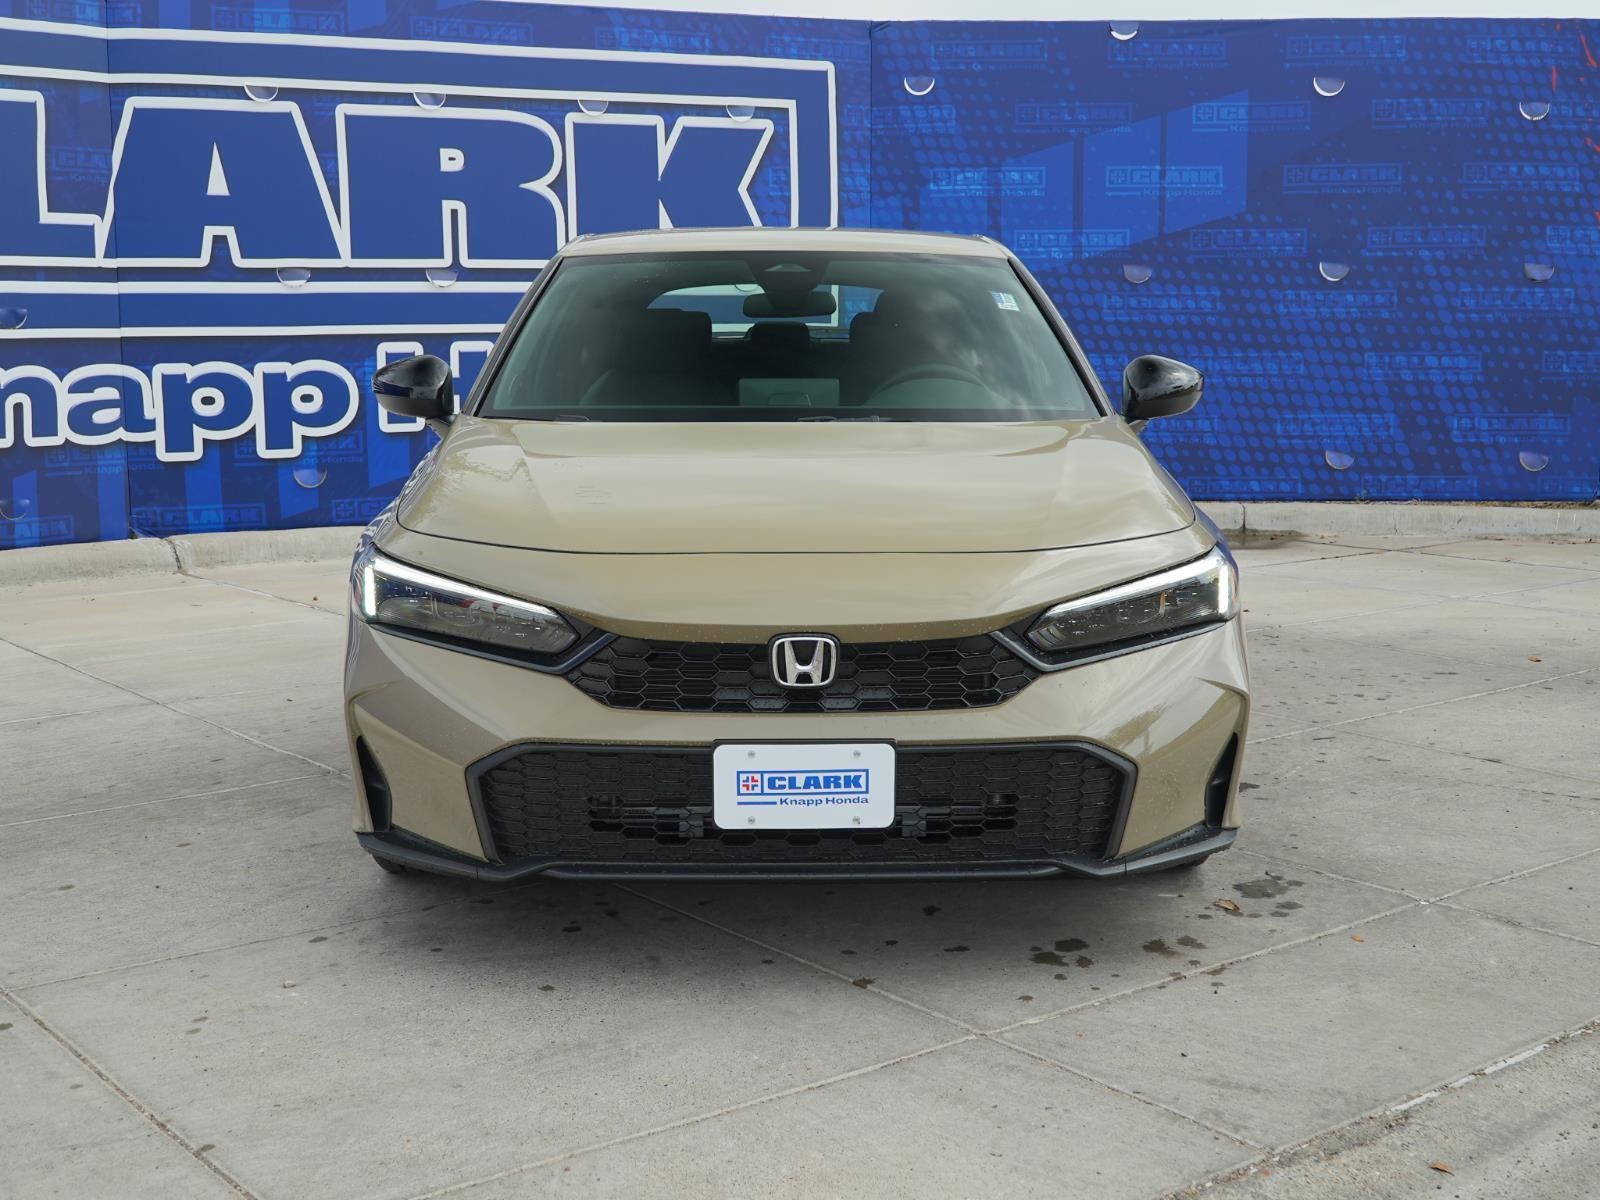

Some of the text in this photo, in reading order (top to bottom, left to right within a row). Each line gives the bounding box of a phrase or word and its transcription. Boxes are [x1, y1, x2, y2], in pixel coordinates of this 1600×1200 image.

[1133, 169, 1217, 183] CLARK
[160, 508, 257, 526] CLARK
[767, 775, 863, 790] CLARK
[779, 796, 869, 807] Knapp Honda
